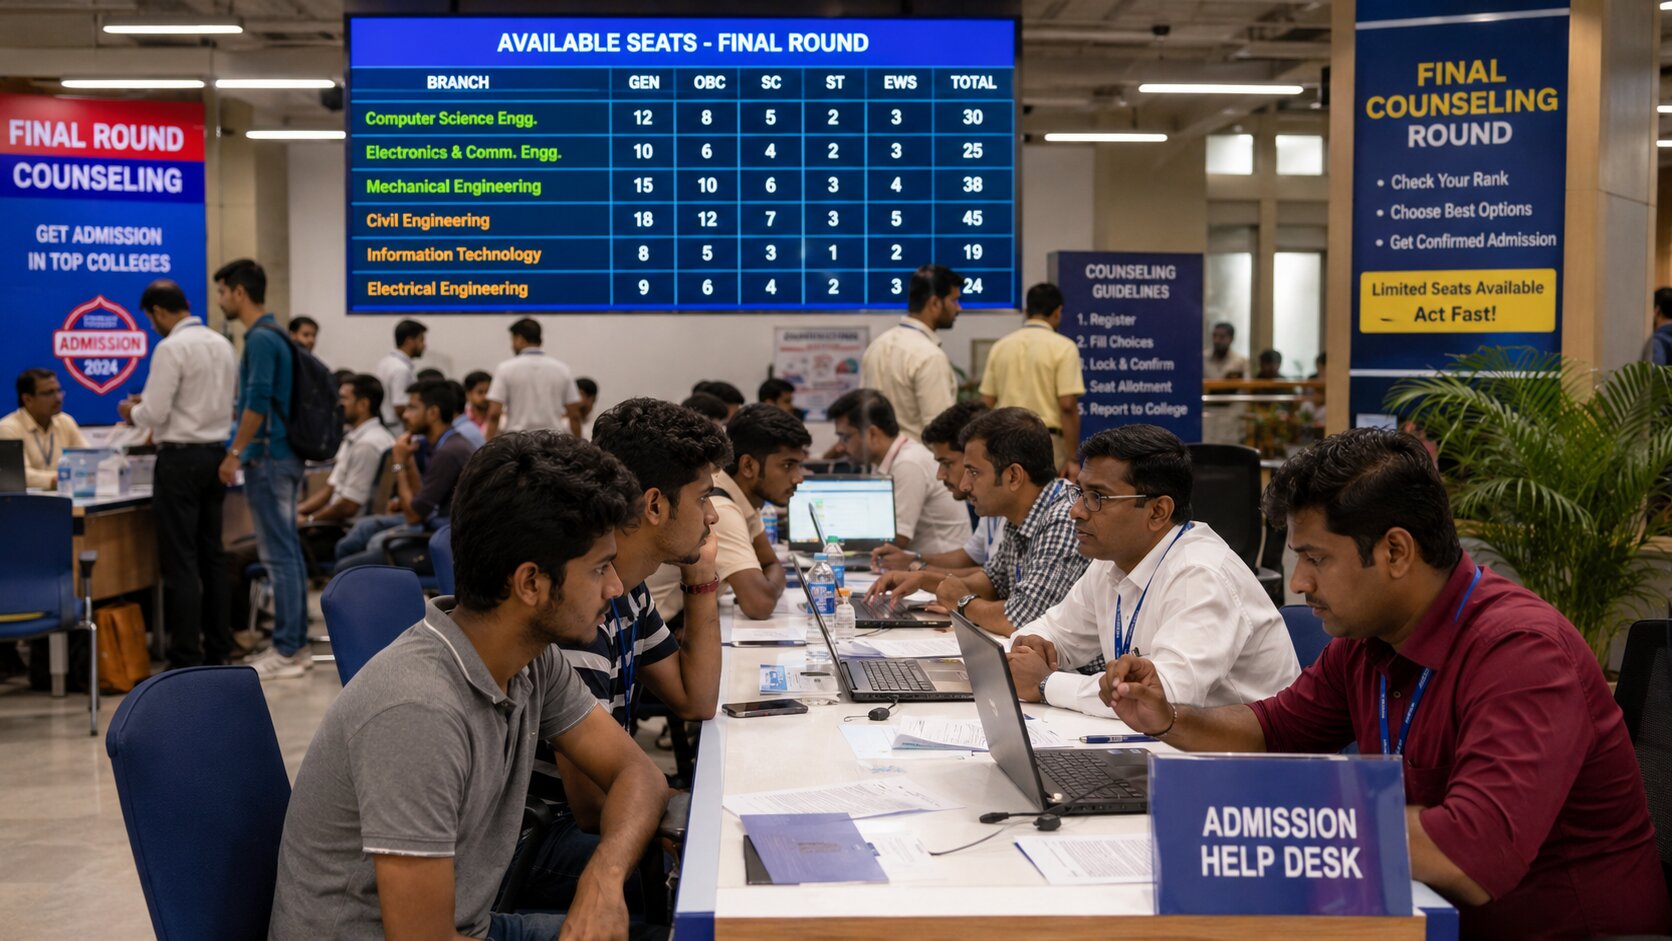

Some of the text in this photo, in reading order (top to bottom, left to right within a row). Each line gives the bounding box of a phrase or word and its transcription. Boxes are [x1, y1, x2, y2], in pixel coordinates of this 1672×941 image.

[497, 33, 620, 52] AVAILABLE
[627, 33, 697, 52] SEATS
[719, 33, 782, 52] FINAL
[789, 33, 869, 52] ROUND
[427, 75, 997, 89] BRANCH GEN OBC SC ST EWS TOTAL
[1418, 59, 1506, 86] FINAL
[1366, 87, 1558, 119] COUNSELING
[366, 109, 983, 128] Computer Science Engg. 12 8 5 2 3 30
[9, 119, 184, 151] FINAL ROUND
[1408, 121, 1512, 147] ROUND
[366, 143, 983, 162] Electronics & Comm. Engg. 10 6 4 2 3 25
[13, 162, 183, 193] COUNSELING
[367, 176, 983, 196] Mechanical Engineering 15 10 6 3 4 38
[1392, 171, 1508, 189] Check Your Rank
[367, 210, 983, 230] Civil Engineering 18 12 7 3 5 45
[1391, 202, 1532, 220] Choose Best Options
[36, 224, 162, 245] GET ADMISSION
[1390, 232, 1556, 249] Get Confirmed Admission
[29, 252, 171, 272] IN TOP COLLEGES
[368, 244, 982, 264] Information Technology 8 5 3 1 2 19
[1085, 264, 1176, 279] COUNSELING
[368, 278, 983, 298] Electrical Engineering 9 6 4 2 3 24
[1093, 284, 1169, 299] GUIDELINES
[1372, 280, 1544, 296] Limited Seats Available
[1077, 313, 1136, 329] 1. Register
[1414, 306, 1496, 322] Act Fast!
[60, 336, 140, 351] ADMISSION
[1077, 335, 1154, 348] 2. Fill Choices
[84, 359, 118, 375] 2024
[1090, 358, 1117, 370] Lock
[1119, 358, 1128, 370] &
[1130, 358, 1174, 370] Confirm
[1090, 380, 1172, 393] Seat Allotment
[1090, 402, 1128, 417] Report
[1131, 404, 1143, 415] to
[1145, 402, 1188, 418] College
[1203, 806, 1357, 839] ADMISSION
[1201, 845, 1363, 878] HELP DESK
